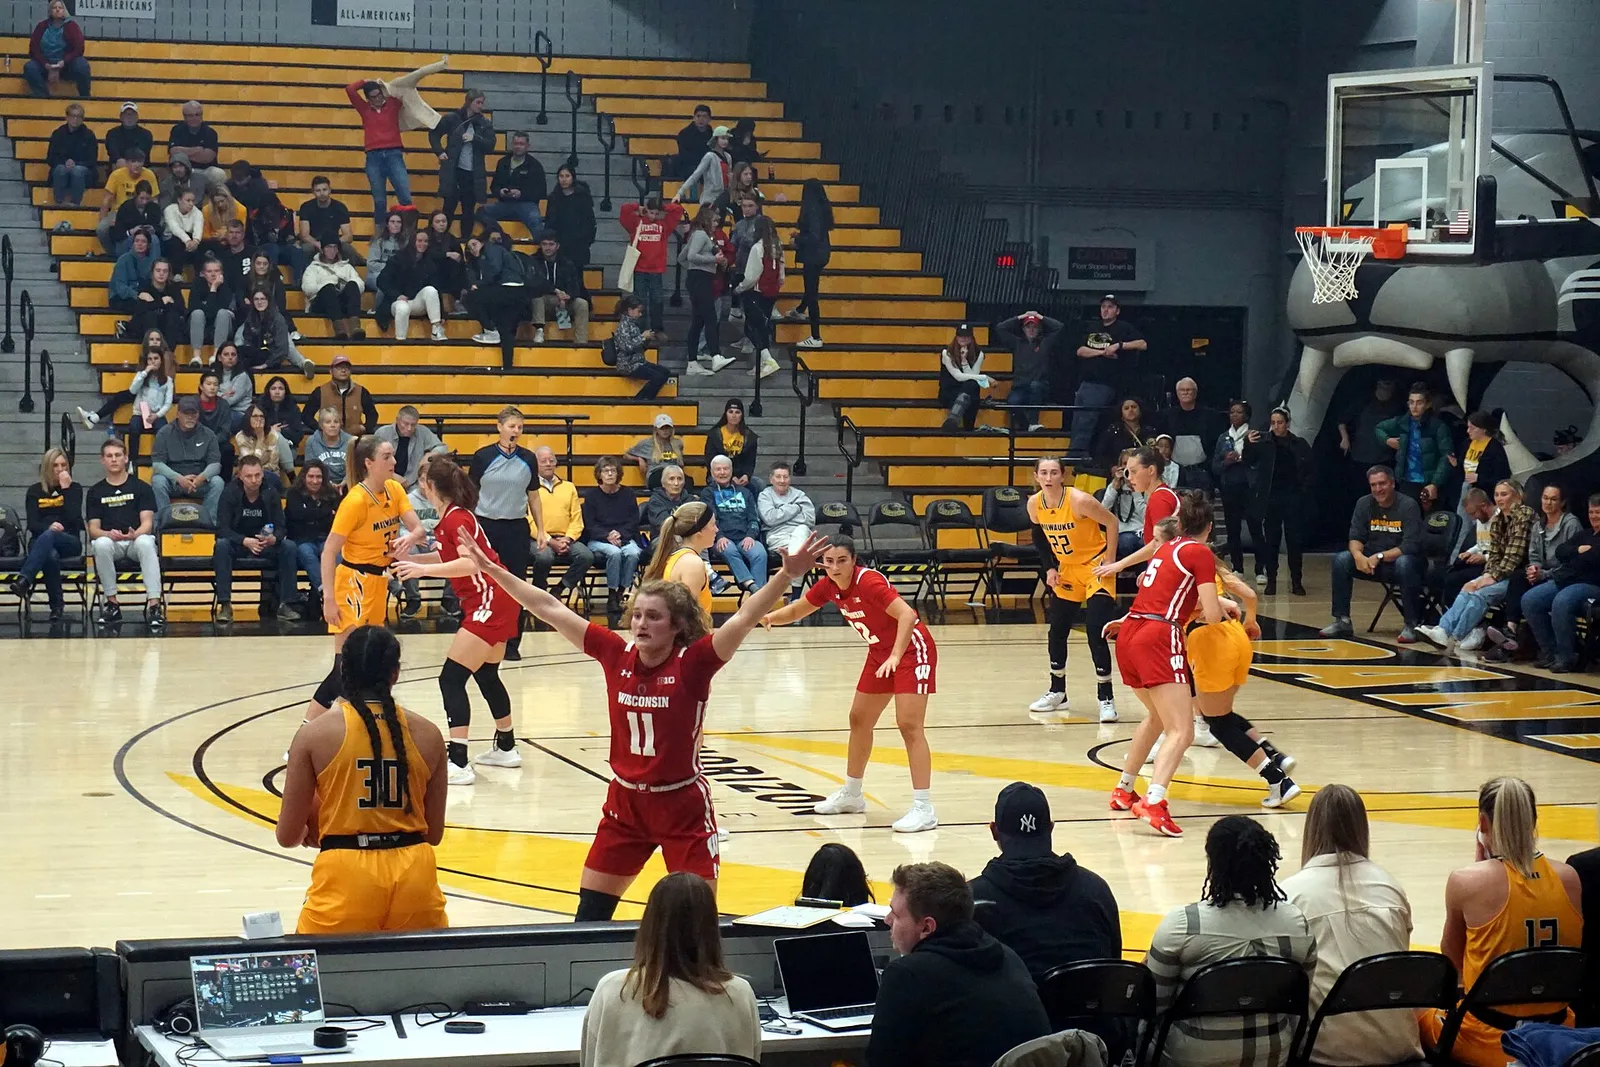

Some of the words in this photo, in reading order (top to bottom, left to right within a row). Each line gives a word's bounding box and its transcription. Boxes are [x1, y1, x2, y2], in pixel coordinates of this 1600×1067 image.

[79, 0, 153, 11] ALL-AMERICANS
[340, 9, 411, 22] ALL-AMERICANS
[1048, 534, 1074, 556] 22
[1142, 558, 1163, 588] 5
[617, 691, 669, 708] WISCONSIN
[626, 711, 656, 757] 11
[355, 757, 406, 810] 30
